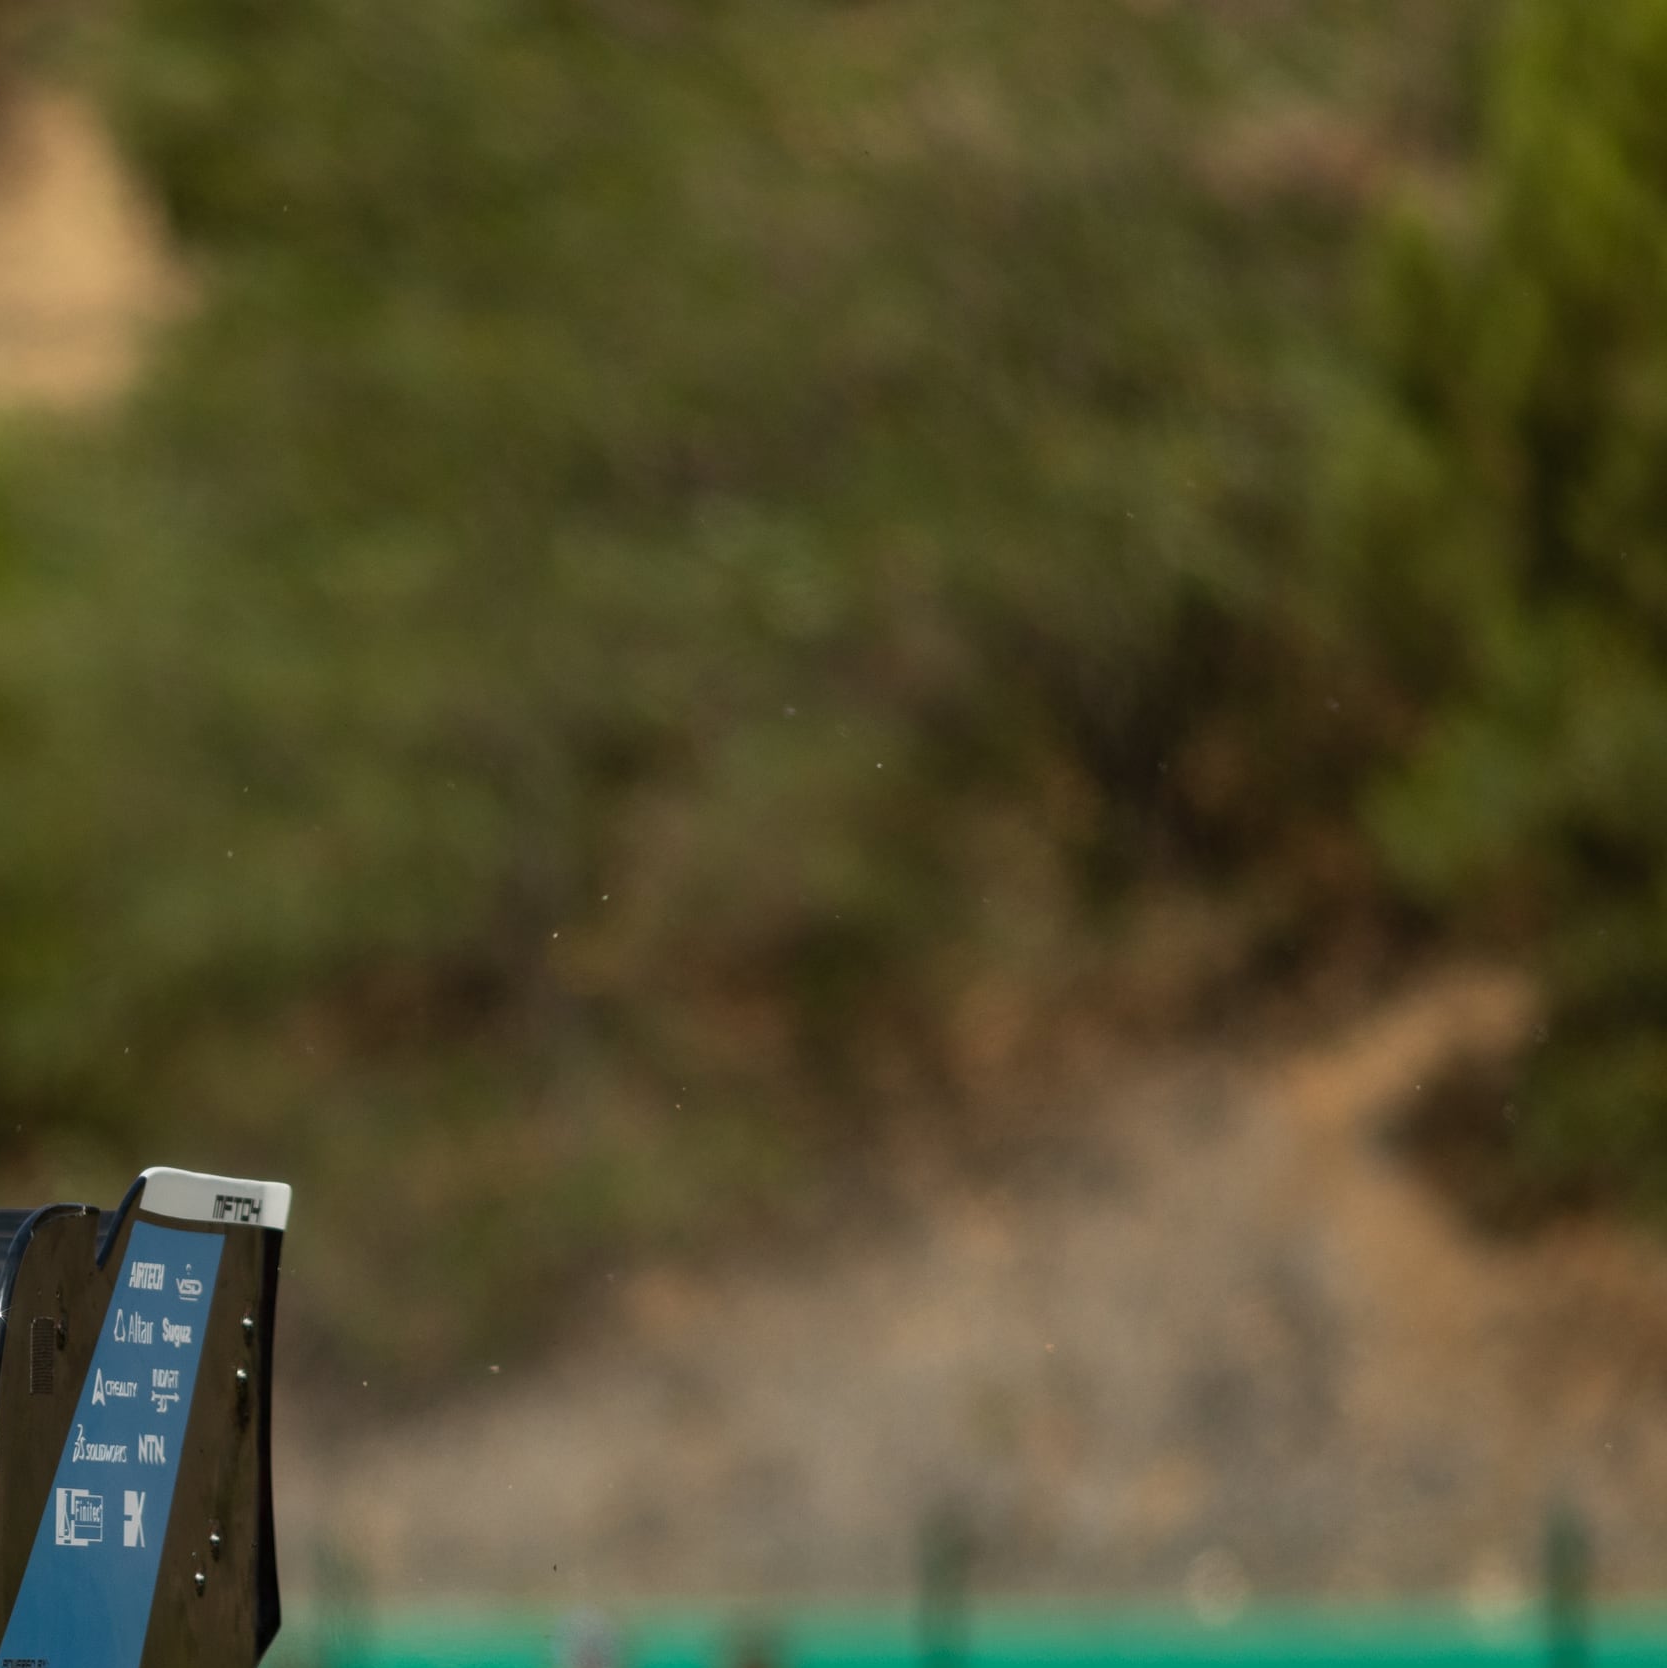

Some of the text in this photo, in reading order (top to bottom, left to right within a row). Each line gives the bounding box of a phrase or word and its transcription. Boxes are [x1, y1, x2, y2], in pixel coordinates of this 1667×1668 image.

[128, 1261, 165, 1291] AIRTECH
[128, 1312, 154, 1344] Altair
[105, 1380, 138, 1397] CREALITY
[86, 1443, 127, 1463] SOLIDWORKS
